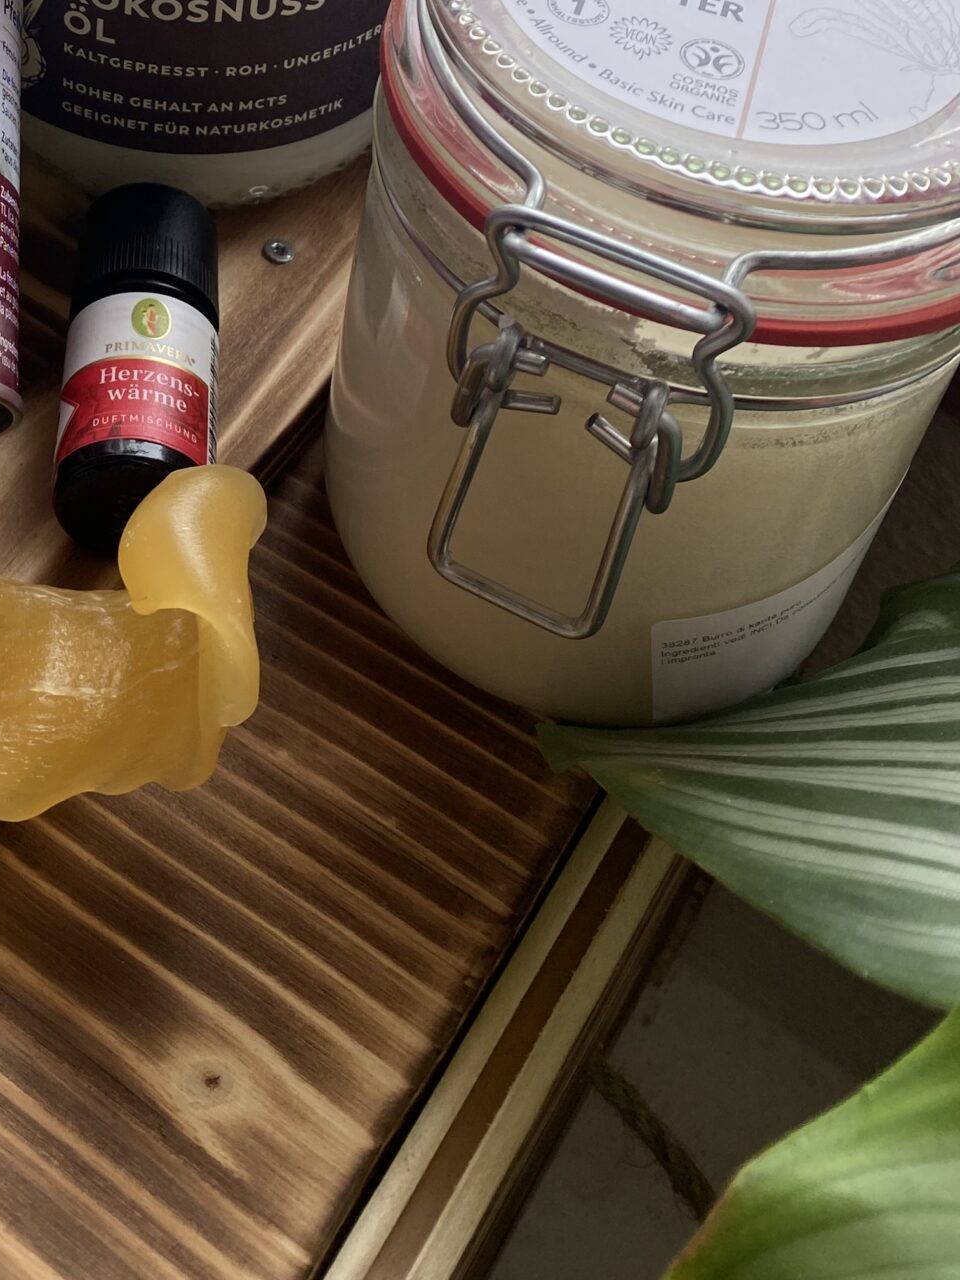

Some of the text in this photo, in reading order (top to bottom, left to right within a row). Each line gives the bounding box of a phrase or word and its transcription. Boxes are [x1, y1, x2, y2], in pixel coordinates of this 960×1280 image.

[63, 3, 116, 45] ÖL
[623, 27, 658, 47] VEGAN
[63, 42, 207, 78] KALTGEPRESST
[225, 63, 267, 79] ROH
[530, 18, 588, 66] Allround
[598, 66, 645, 100] Basic
[647, 89, 685, 113] Skin
[690, 101, 736, 126] Care
[62, 77, 288, 114] HOHER GEHALT AN MCTS
[668, 81, 737, 107] ORGANIC
[671, 72, 739, 98] COSMOS
[61, 97, 344, 136] GEEIGNET FÜR NATURKOSMETIK
[756, 101, 879, 132] 350 ml
[99, 366, 200, 399] Herzens-
[108, 384, 188, 413] wärme
[92, 414, 198, 444] DUFTMISCHUNG
[661, 641, 721, 658] Ingredienti
[702, 631, 733, 643] Burro
